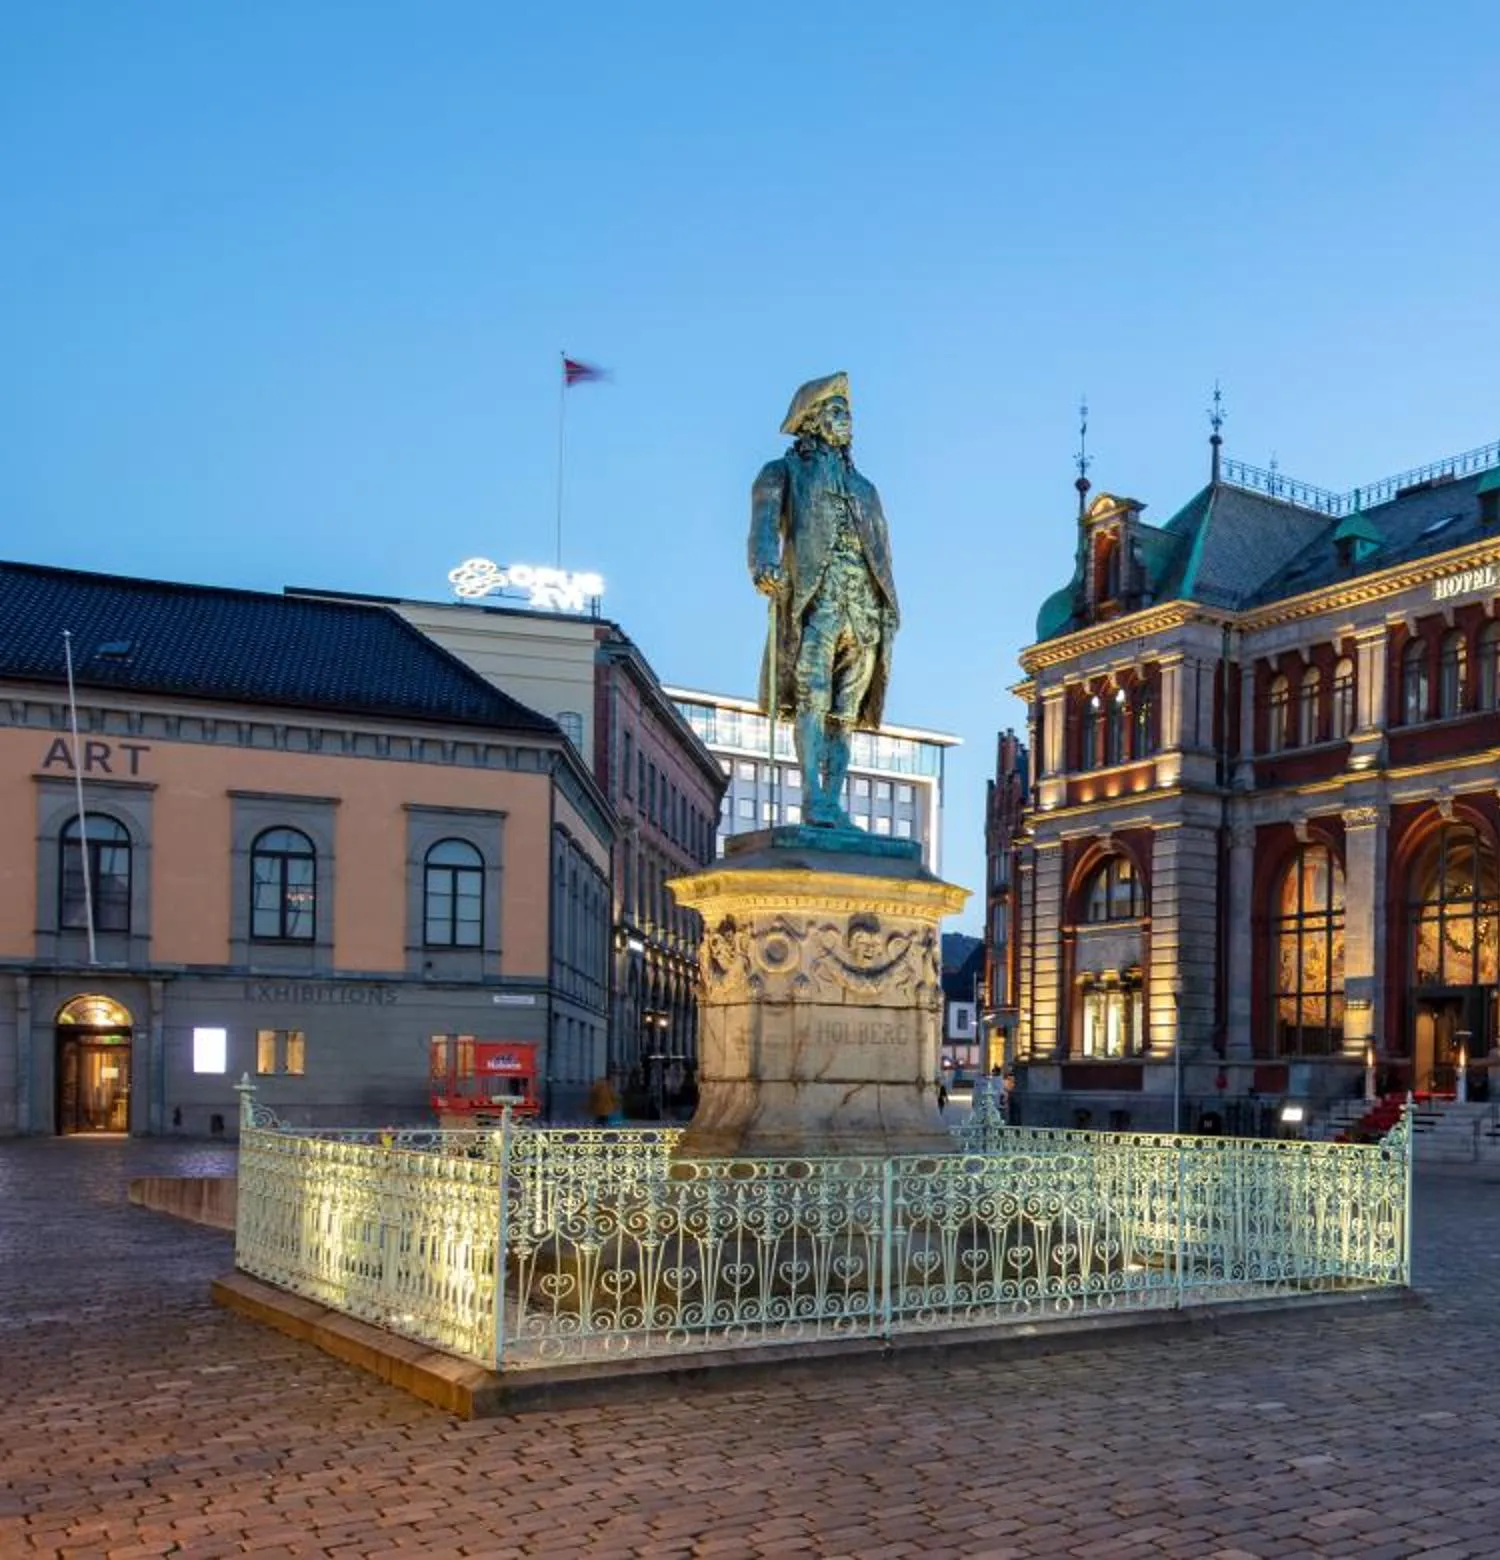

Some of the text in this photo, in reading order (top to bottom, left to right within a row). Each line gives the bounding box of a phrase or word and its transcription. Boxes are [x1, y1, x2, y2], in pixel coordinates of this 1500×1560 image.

[1433, 565, 1496, 600] HOTEL
[42, 736, 151, 776] ART
[244, 981, 399, 1006] EXHIBITIONS
[815, 1020, 909, 1046] HOLBERG
